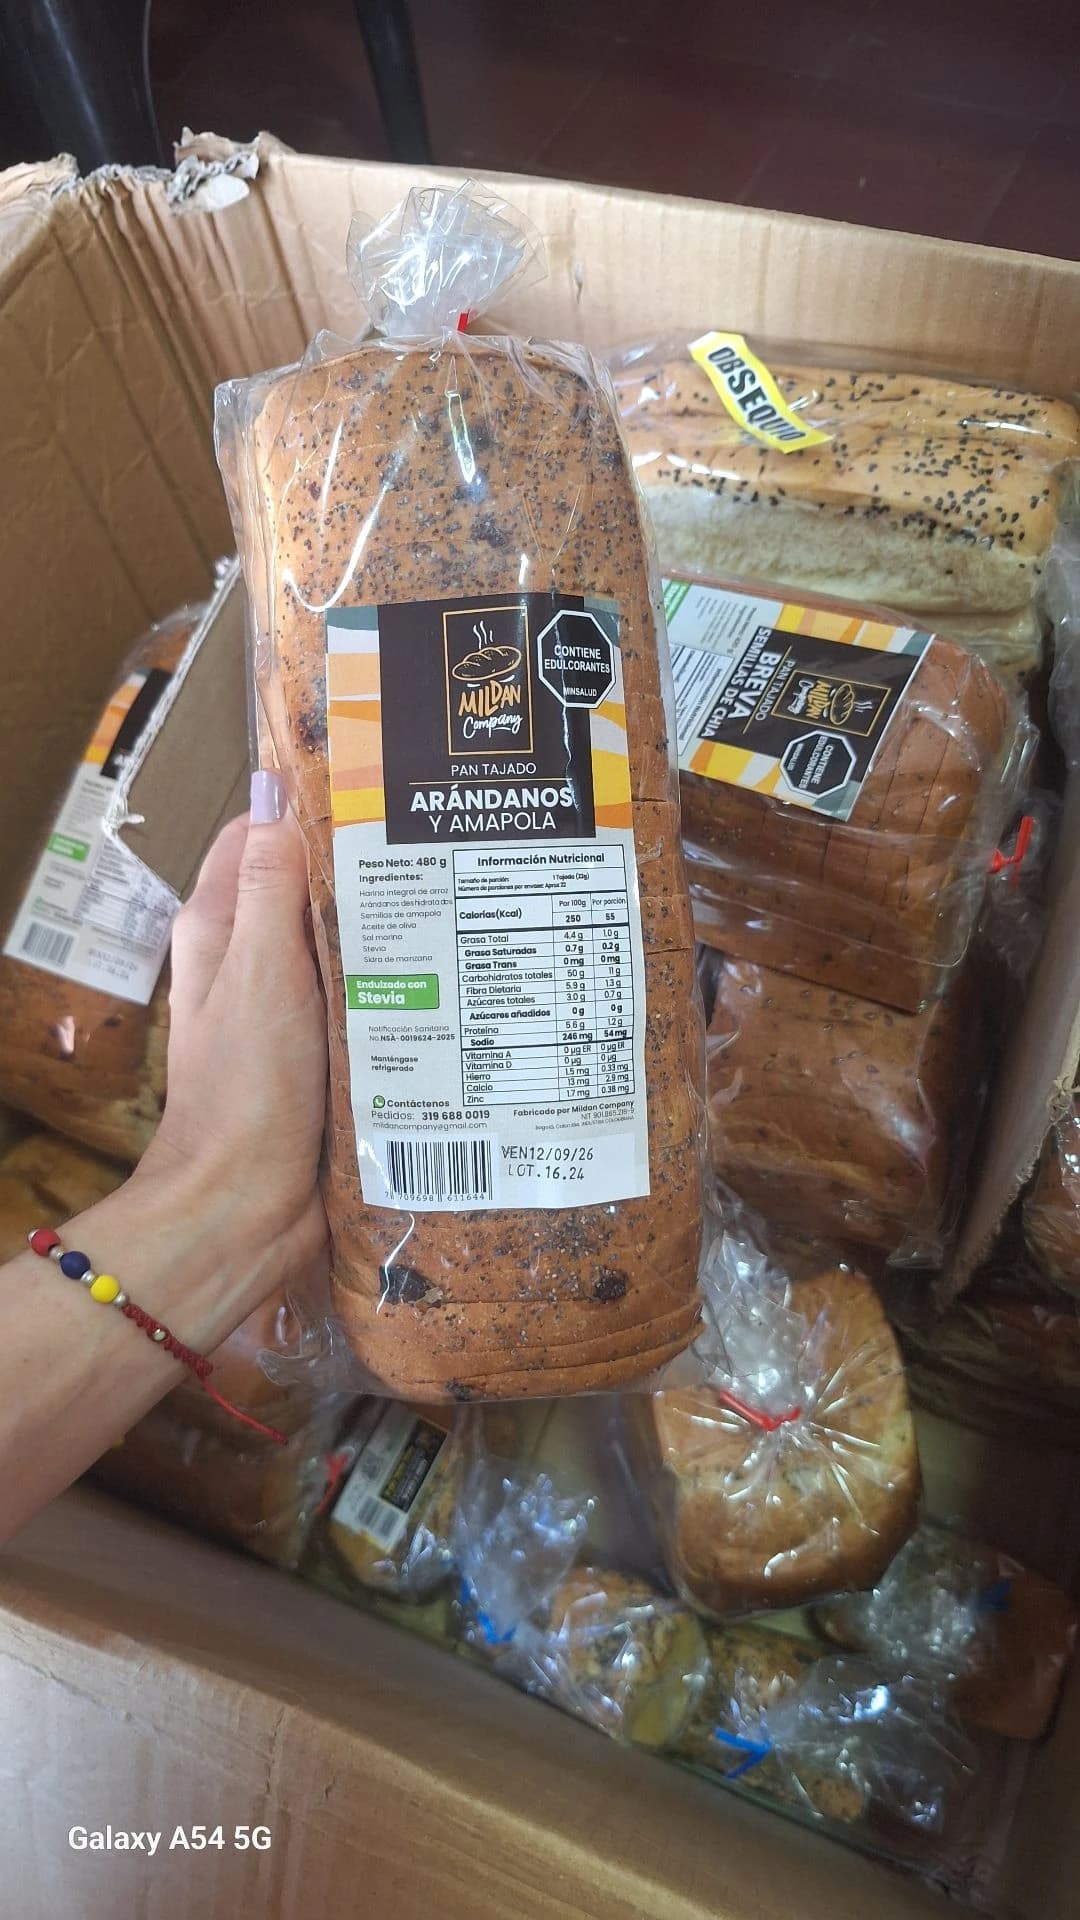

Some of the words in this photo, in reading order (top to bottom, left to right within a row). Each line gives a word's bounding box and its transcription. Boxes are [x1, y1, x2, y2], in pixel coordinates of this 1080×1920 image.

[708, 346, 806, 441] OBSEQUIO
[554, 644, 601, 660] CONTIENE
[730, 628, 772, 687] SEMILLAS
[544, 659, 610, 673] EDULCORANTES
[776, 660, 795, 682] PAN
[727, 651, 783, 720] BREVA
[563, 686, 597, 697] MINSALUD
[720, 686, 735, 706] DE
[458, 680, 521, 718] MILDAN
[755, 682, 782, 721] TAJADO
[701, 703, 728, 737] CHIA
[463, 713, 523, 739] Company
[799, 736, 828, 789] EDULCORANTES
[811, 744, 833, 785] CONTIENE
[451, 765, 479, 777] PAN
[482, 762, 536, 776] TAJADO
[410, 784, 574, 812] ARÁNDANOS
[429, 815, 442, 833] Y
[449, 812, 556, 832] AMAPOLA
[359, 860, 383, 868] Peso
[386, 858, 413, 868] Neto:
[416, 857, 436, 866] 480
[440, 859, 447, 868] g
[478, 855, 546, 866] Información
[549, 853, 604, 863] Nutricional
[360, 873, 423, 884] Ingredientes:
[387, 889, 416, 898] integral
[571, 899, 586, 907] 100g
[406, 910, 441, 919] amapola
[578, 932, 583, 941] g
[614, 930, 618, 939] g
[461, 936, 486, 944] Grasa
[488, 935, 508, 943] Total
[492, 947, 536, 955] Saturadas
[578, 945, 583, 954] g
[614, 943, 619, 952] g
[570, 958, 584, 966] mg
[607, 955, 620, 964] mg
[465, 962, 492, 970] Grasa
[493, 961, 517, 969] Trans
[568, 969, 577, 977] 50
[579, 970, 584, 978] g
[615, 968, 620, 977] g
[462, 973, 522, 983] Carbohidratos
[524, 972, 552, 980] totales
[357, 981, 406, 989] Endulzado
[408, 981, 427, 989] con
[566, 982, 578, 990] 5.9
[580, 983, 585, 991] g
[606, 979, 614, 987] 1.3
[616, 980, 621, 989] g
[466, 987, 487, 995] Fibra
[489, 985, 522, 993] Dietaria
[358, 991, 405, 1005] Stevia
[567, 993, 578, 1001] 3.0
[580, 994, 585, 1002] g
[605, 990, 615, 998] 0.7
[616, 991, 621, 1000] g
[467, 997, 505, 1007] Azúcares
[507, 995, 535, 1004] totales
[579, 1008, 584, 1016] g
[617, 1005, 622, 1013] g
[470, 1011, 509, 1021] Azúcares
[511, 1009, 550, 1018] añadidos
[566, 1021, 577, 1029] 5.6
[579, 1022, 584, 1030] g
[608, 1018, 616, 1026] 1.2
[617, 1019, 622, 1027] g
[369, 1025, 413, 1033] Notificación
[415, 1024, 449, 1032] Sanitaria
[465, 1026, 498, 1035] Proteína
[563, 1033, 577, 1041] 246
[579, 1033, 593, 1042] mg
[615, 1029, 627, 1038] mg
[471, 1038, 494, 1046] Sodio
[564, 1046, 568, 1054] 0
[583, 1045, 591, 1053] ER
[370, 1056, 418, 1064] Manténgase
[465, 1051, 503, 1060] Vitamina
[372, 1064, 414, 1073] refrigerado
[466, 1061, 504, 1070] Vitamina
[506, 1061, 512, 1069] D
[617, 1063, 628, 1072] mg
[577, 1068, 589, 1076] mg
[466, 1073, 490, 1081] Hierro
[606, 1074, 616, 1082] 2.9
[618, 1073, 628, 1082] mg
[568, 1078, 575, 1086] 13
[577, 1078, 589, 1087] mg
[467, 1084, 493, 1092] Calcio
[620, 1085, 629, 1094] mg
[577, 1090, 590, 1098] mg
[387, 1099, 450, 1108] Contáctenos
[467, 1095, 484, 1103] Zinc
[557, 1108, 570, 1116] por
[572, 1105, 597, 1113] Mildan
[599, 1101, 634, 1109] Company
[371, 1110, 415, 1120] Pedidos:
[422, 1112, 440, 1121] 319
[443, 1111, 463, 1120] 688
[465, 1110, 490, 1120] 0019
[373, 1121, 487, 1130] mildancompany@gmail.com
